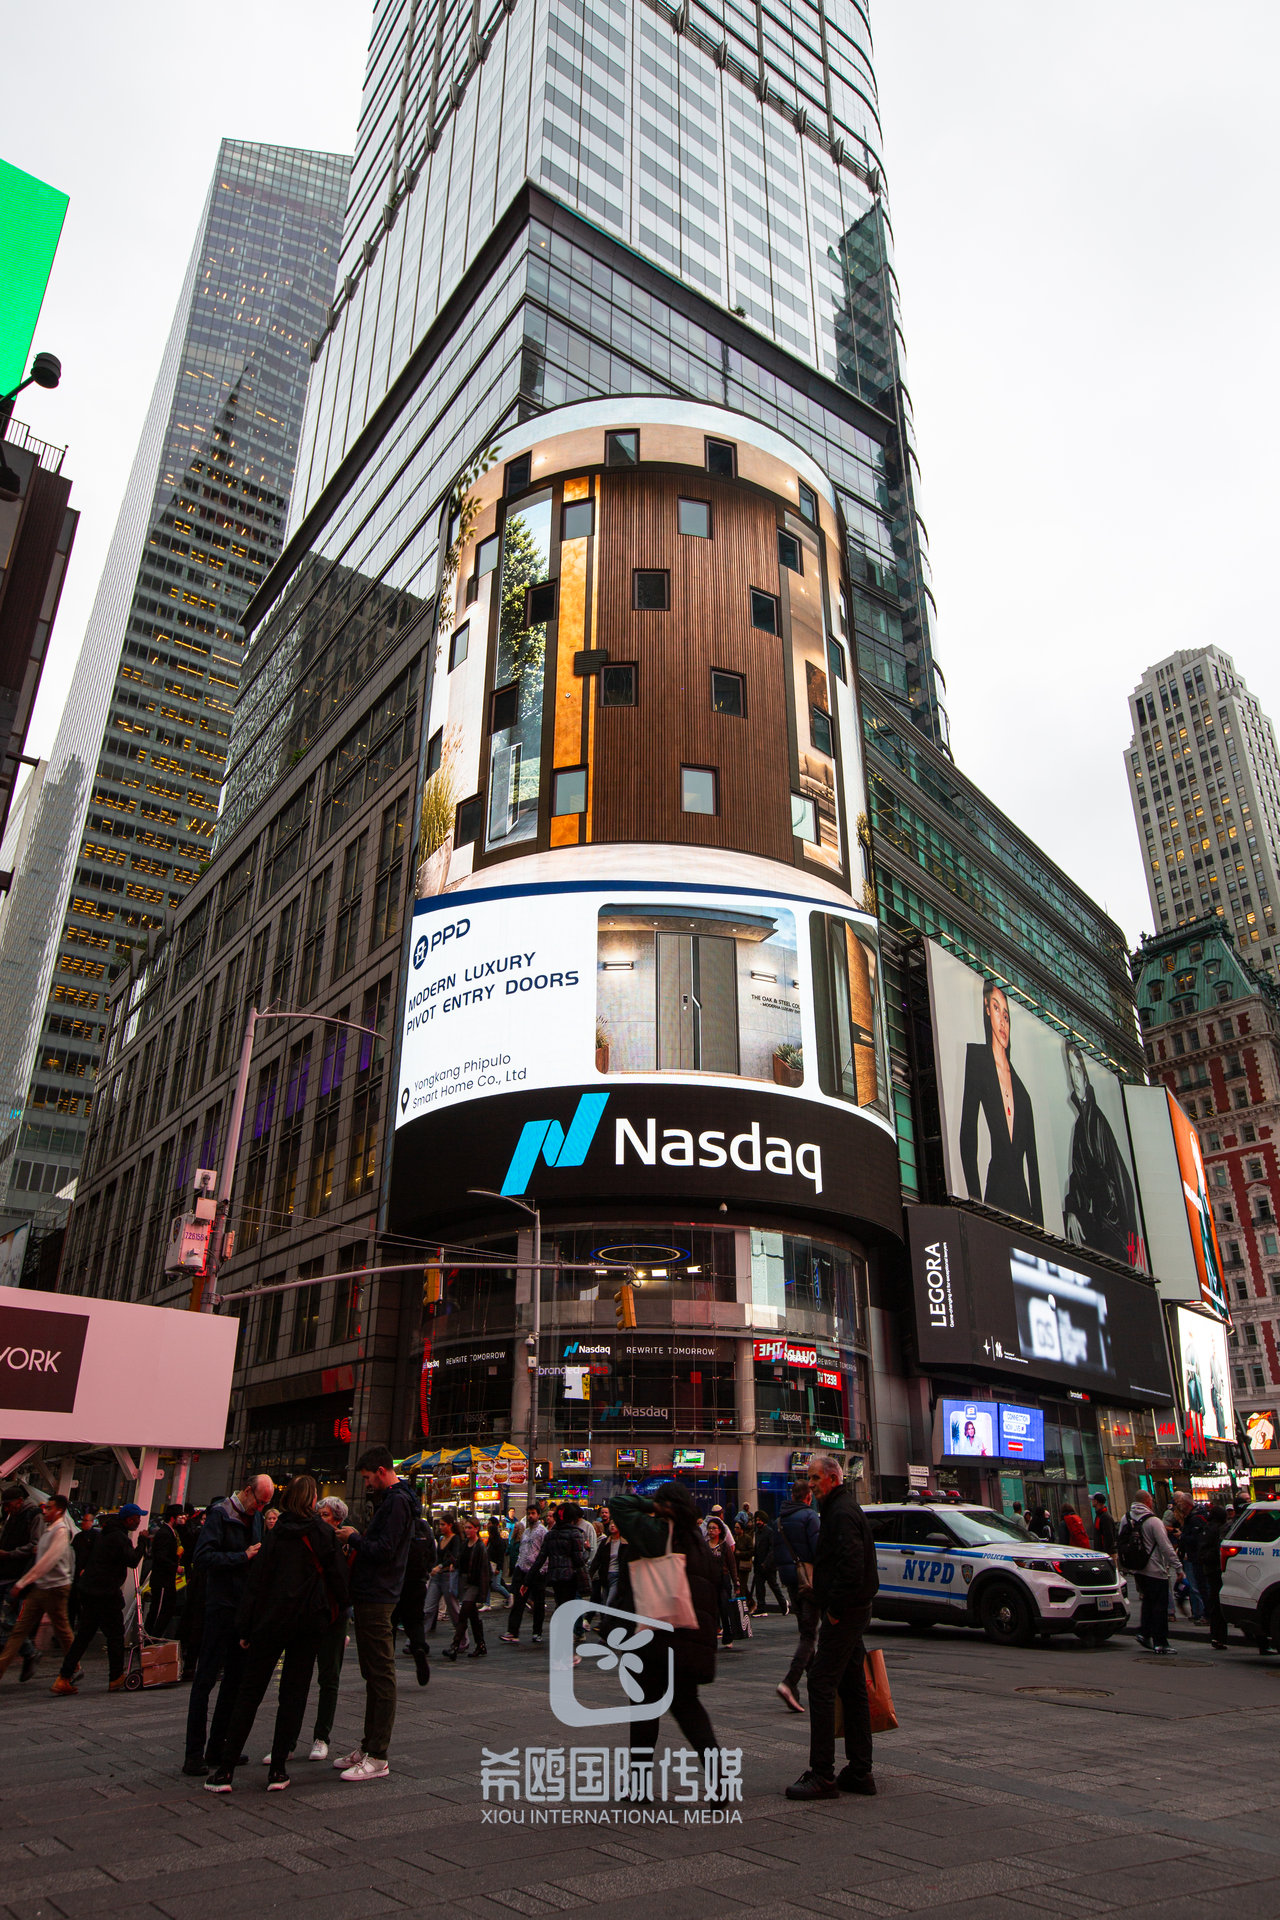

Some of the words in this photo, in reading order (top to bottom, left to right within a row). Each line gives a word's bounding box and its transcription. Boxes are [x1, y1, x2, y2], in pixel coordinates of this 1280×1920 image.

[431, 918, 471, 952] PPD
[408, 973, 456, 1013] MODERN
[464, 951, 536, 982] LUXURY
[406, 1005, 436, 1036] PIVOT
[442, 984, 495, 1014] ENTRY
[505, 970, 579, 995] DOORS
[762, 995, 772, 1003] OAK
[778, 999, 792, 1008] STEEL
[412, 1089, 438, 1109] Smart
[440, 1079, 474, 1098] Home
[477, 1074, 502, 1088] Co.,
[506, 1067, 527, 1082] Ltd
[414, 1065, 460, 1092] Yongkang
[464, 1053, 511, 1075] Phipulo
[615, 1118, 823, 1194] Nasdaq
[925, 1242, 948, 1327] LEGORA
[446, 1355, 468, 1366] REWRITE
[470, 1351, 506, 1362] TOMORROW
[578, 1345, 611, 1356] Nasdaq
[626, 1346, 664, 1354] REWRITE
[668, 1346, 716, 1355] TOMORROW
[623, 1405, 669, 1420] Nasdaq
[902, 1558, 955, 1585] NYPD
[983, 1552, 1004, 1560] POLICE
